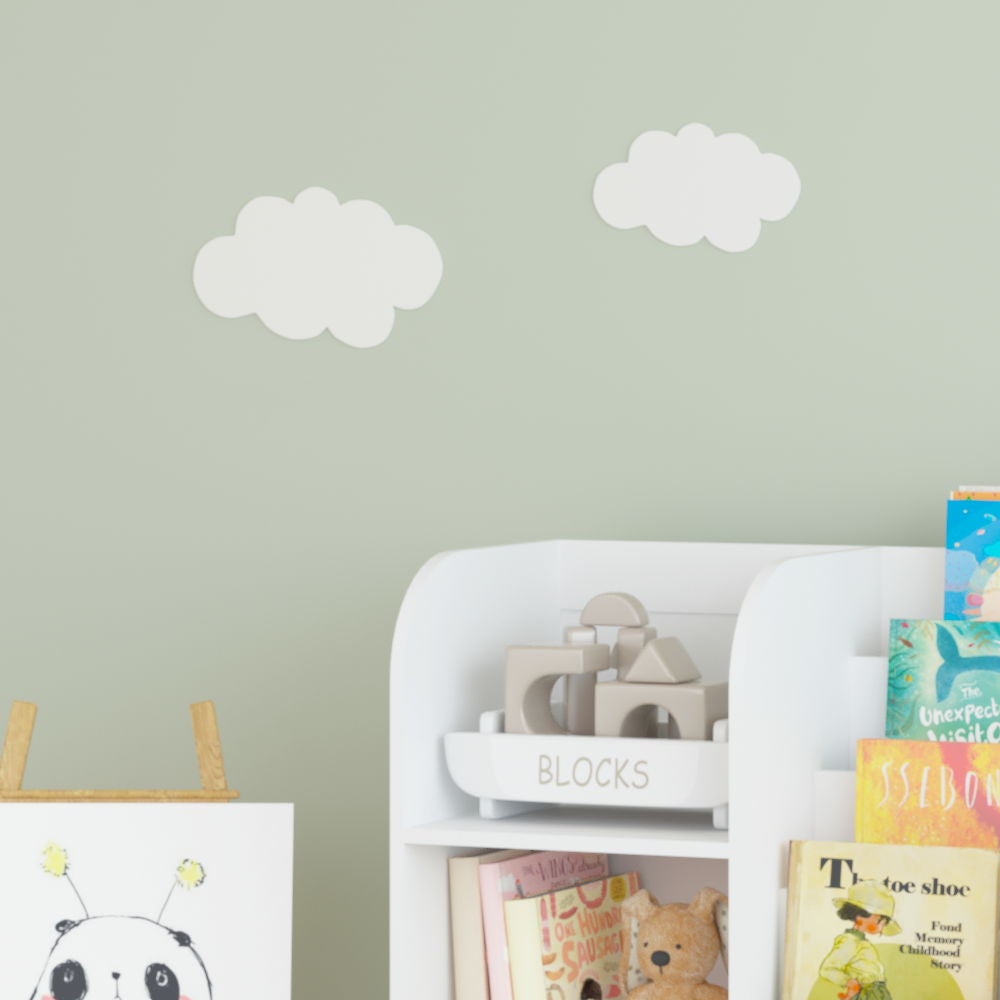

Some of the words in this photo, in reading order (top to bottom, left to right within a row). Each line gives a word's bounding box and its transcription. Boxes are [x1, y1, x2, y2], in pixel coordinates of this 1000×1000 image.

[538, 754, 650, 790] BLOCKS
[883, 876, 917, 894] toe
[921, 877, 971, 897] shoe
[931, 920, 962, 933] Fond
[915, 931, 964, 946] Memory
[899, 944, 961, 958] Childhood
[930, 959, 962, 973] Story
